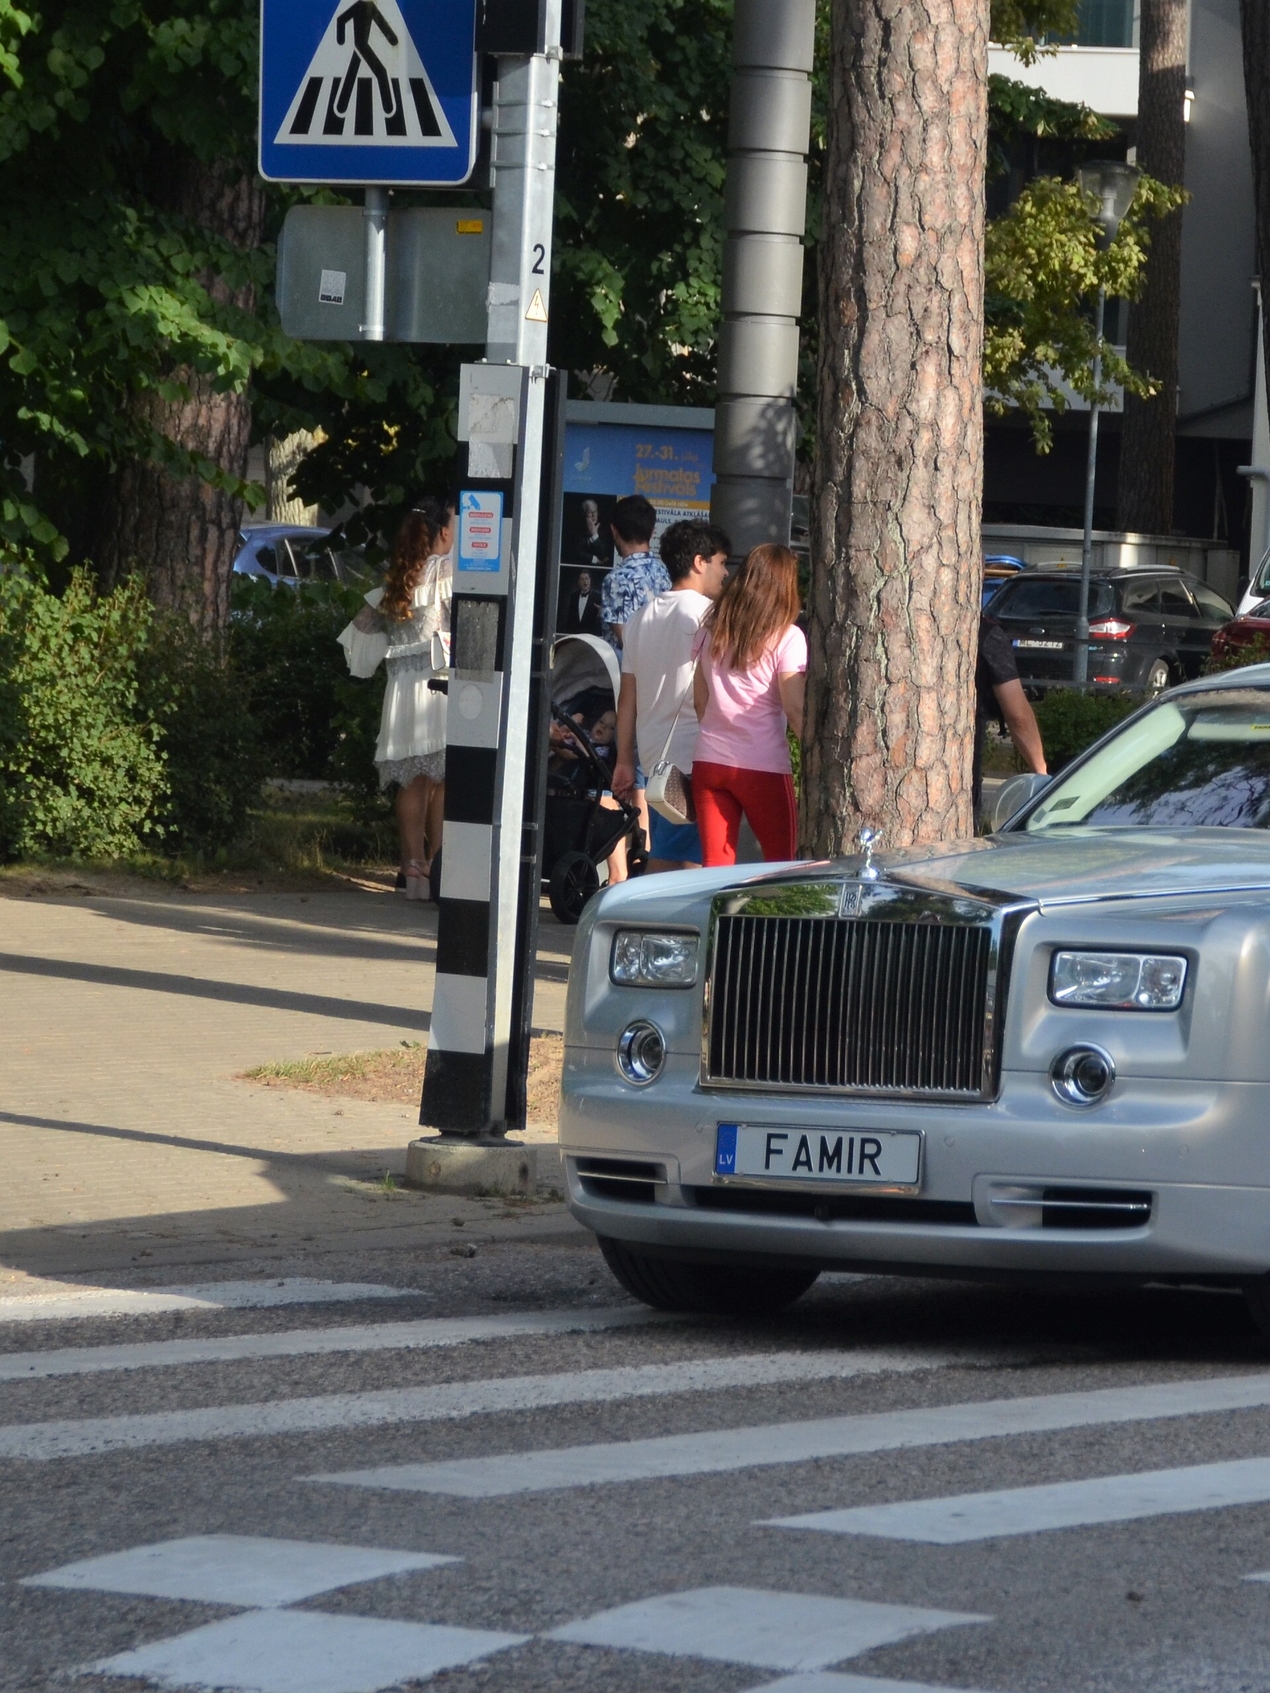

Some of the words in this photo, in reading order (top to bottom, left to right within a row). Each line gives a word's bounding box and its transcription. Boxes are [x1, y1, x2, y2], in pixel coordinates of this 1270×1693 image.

[531, 243, 545, 275] 2
[719, 1154, 734, 1165] LV
[764, 1132, 882, 1176] FAMIR
